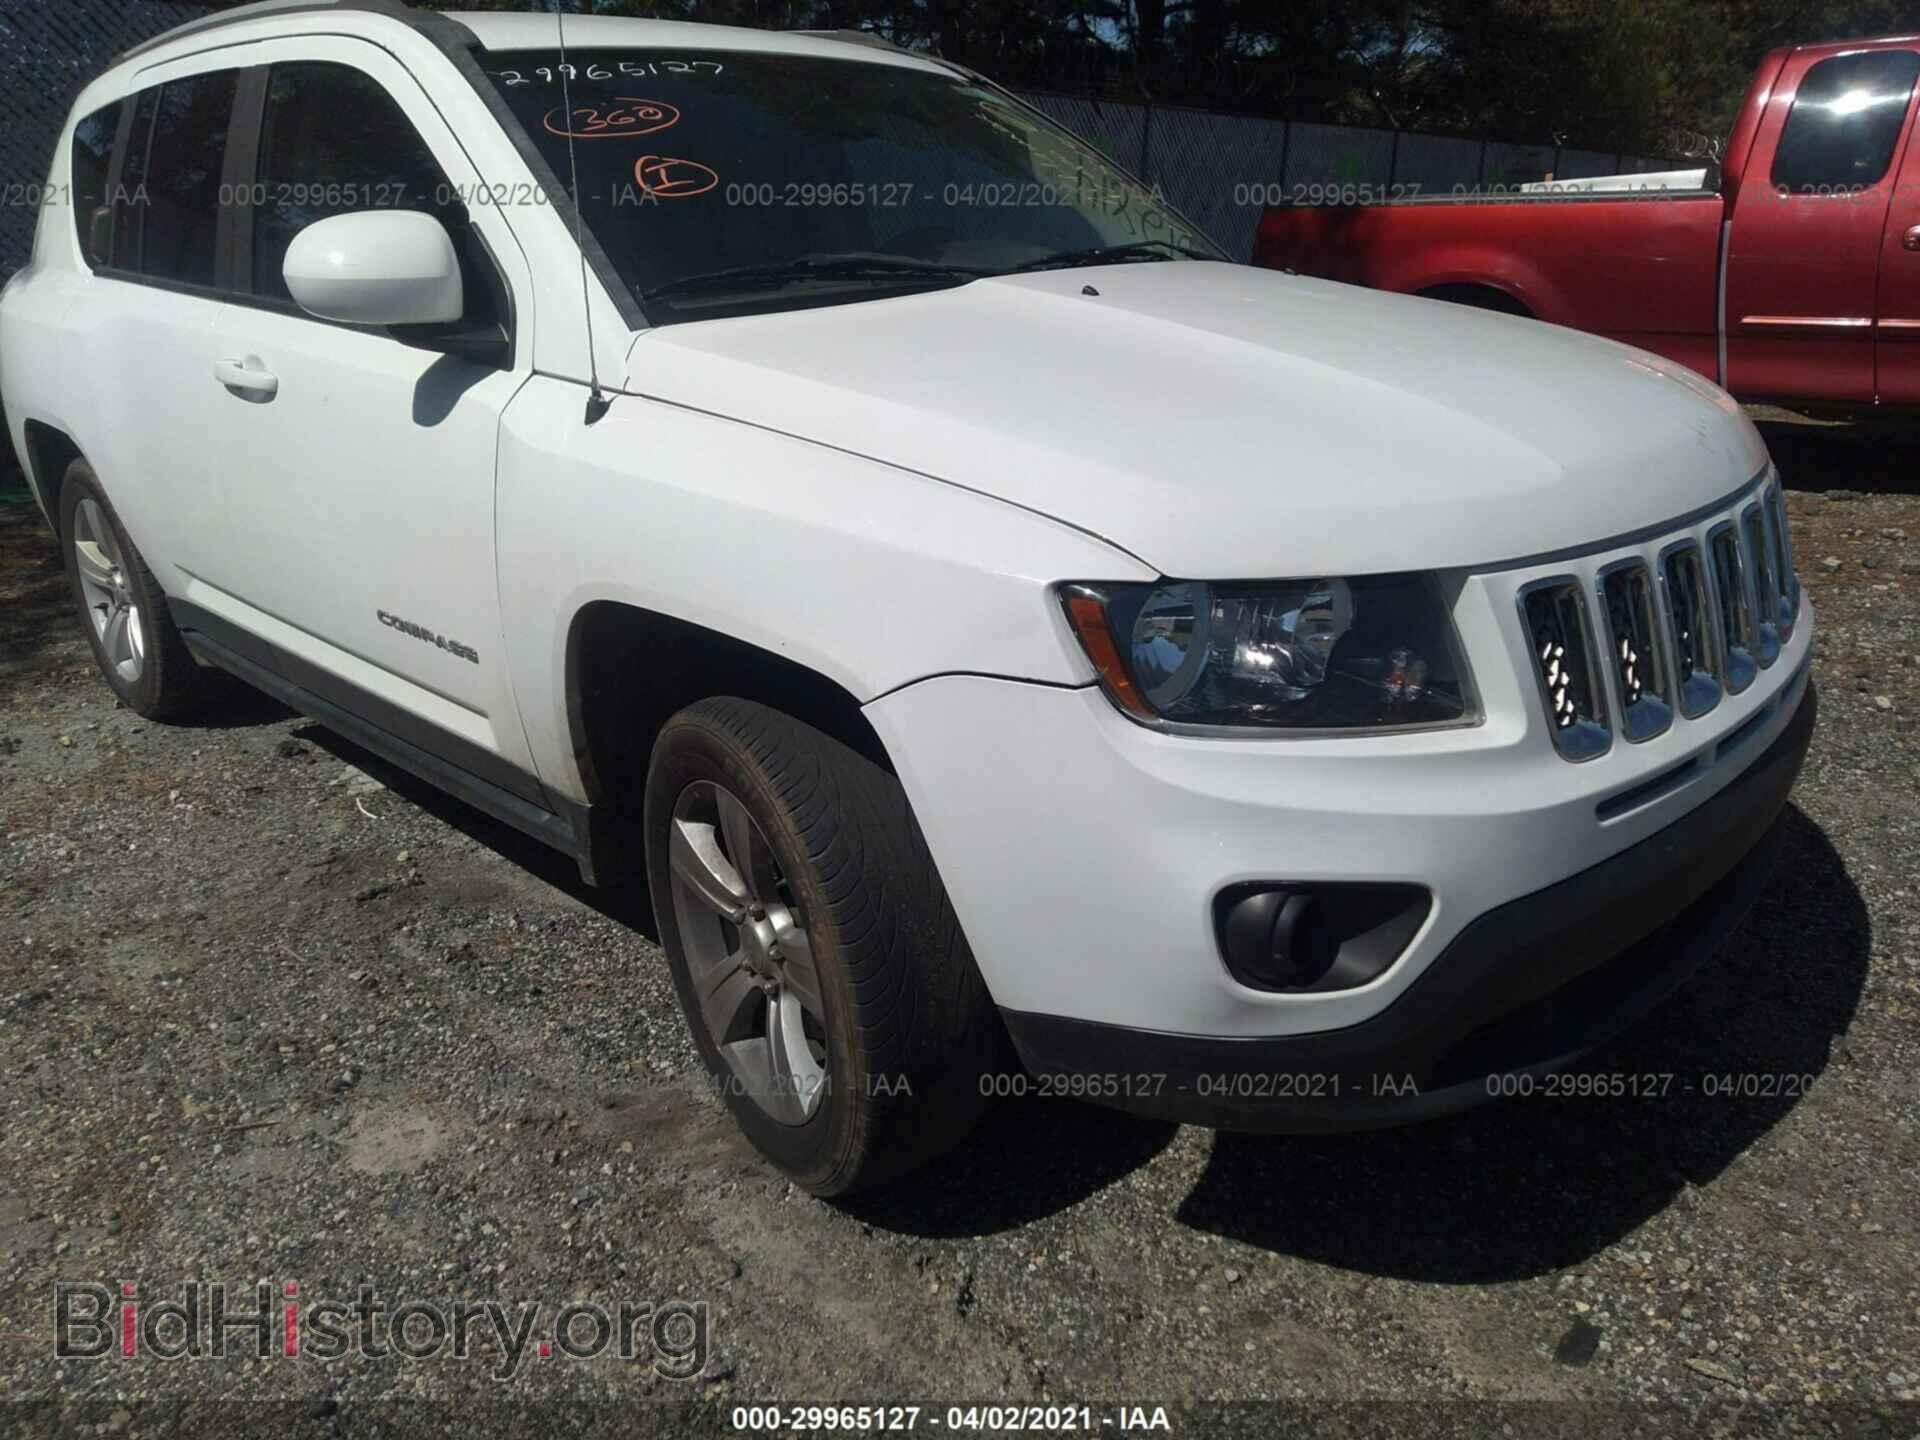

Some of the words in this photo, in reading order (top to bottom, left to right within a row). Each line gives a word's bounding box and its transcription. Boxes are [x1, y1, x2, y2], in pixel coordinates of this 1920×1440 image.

[498, 61, 724, 85] 29965127
[572, 106, 663, 131] 360
[376, 609, 480, 665] COMPASS
